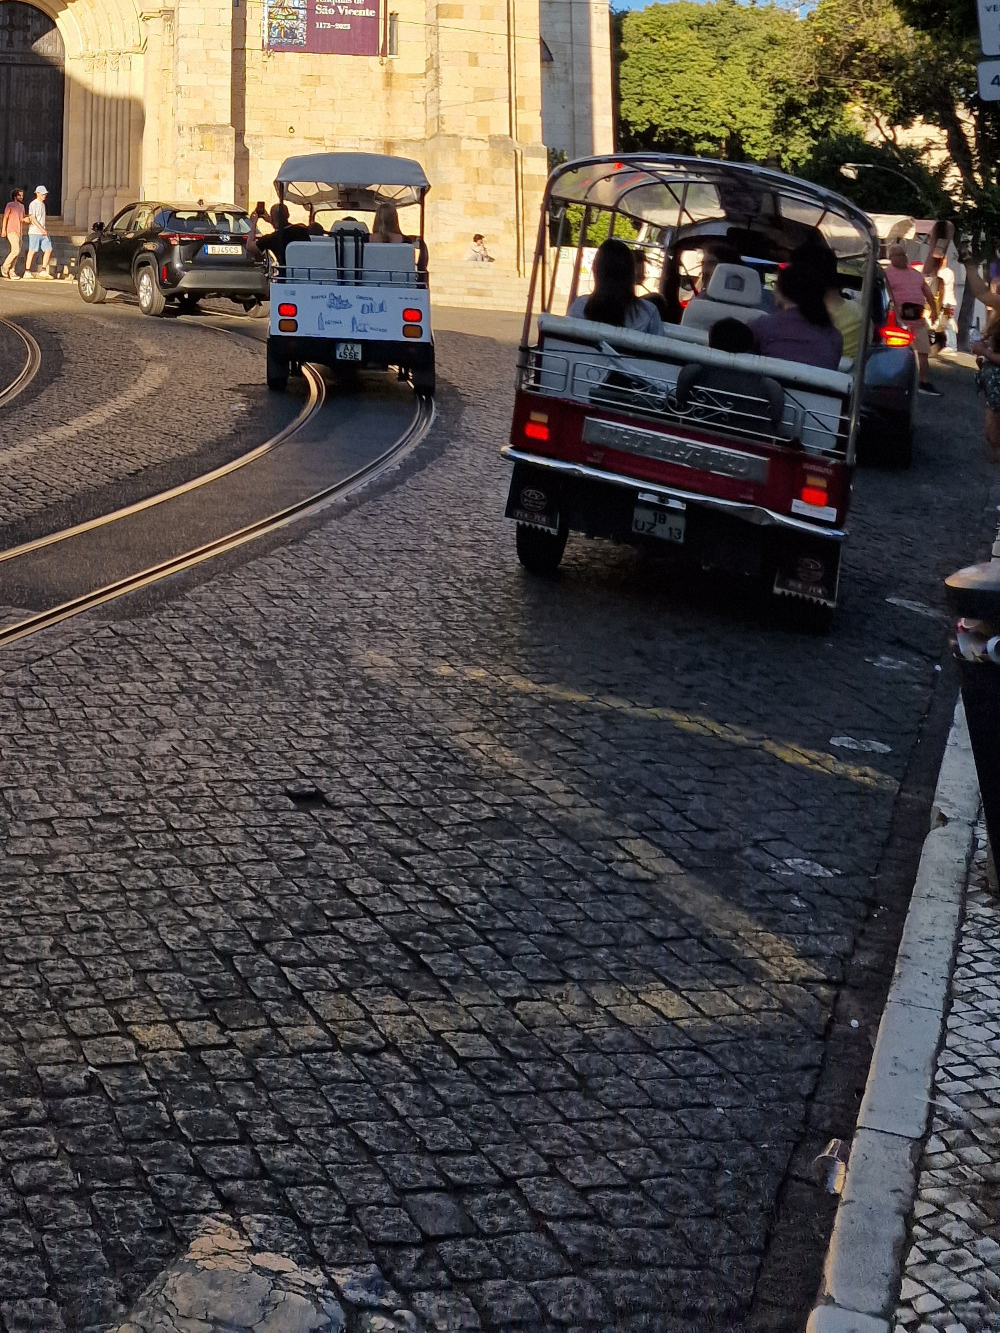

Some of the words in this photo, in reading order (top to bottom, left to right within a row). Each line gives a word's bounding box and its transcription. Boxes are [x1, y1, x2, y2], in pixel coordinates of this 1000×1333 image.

[315, 4, 336, 15] São
[337, 5, 376, 16] Vicente
[985, 4, 1000, 13] VE
[653, 512, 667, 525] 18
[634, 519, 657, 535] UZ
[668, 526, 682, 540] 13
